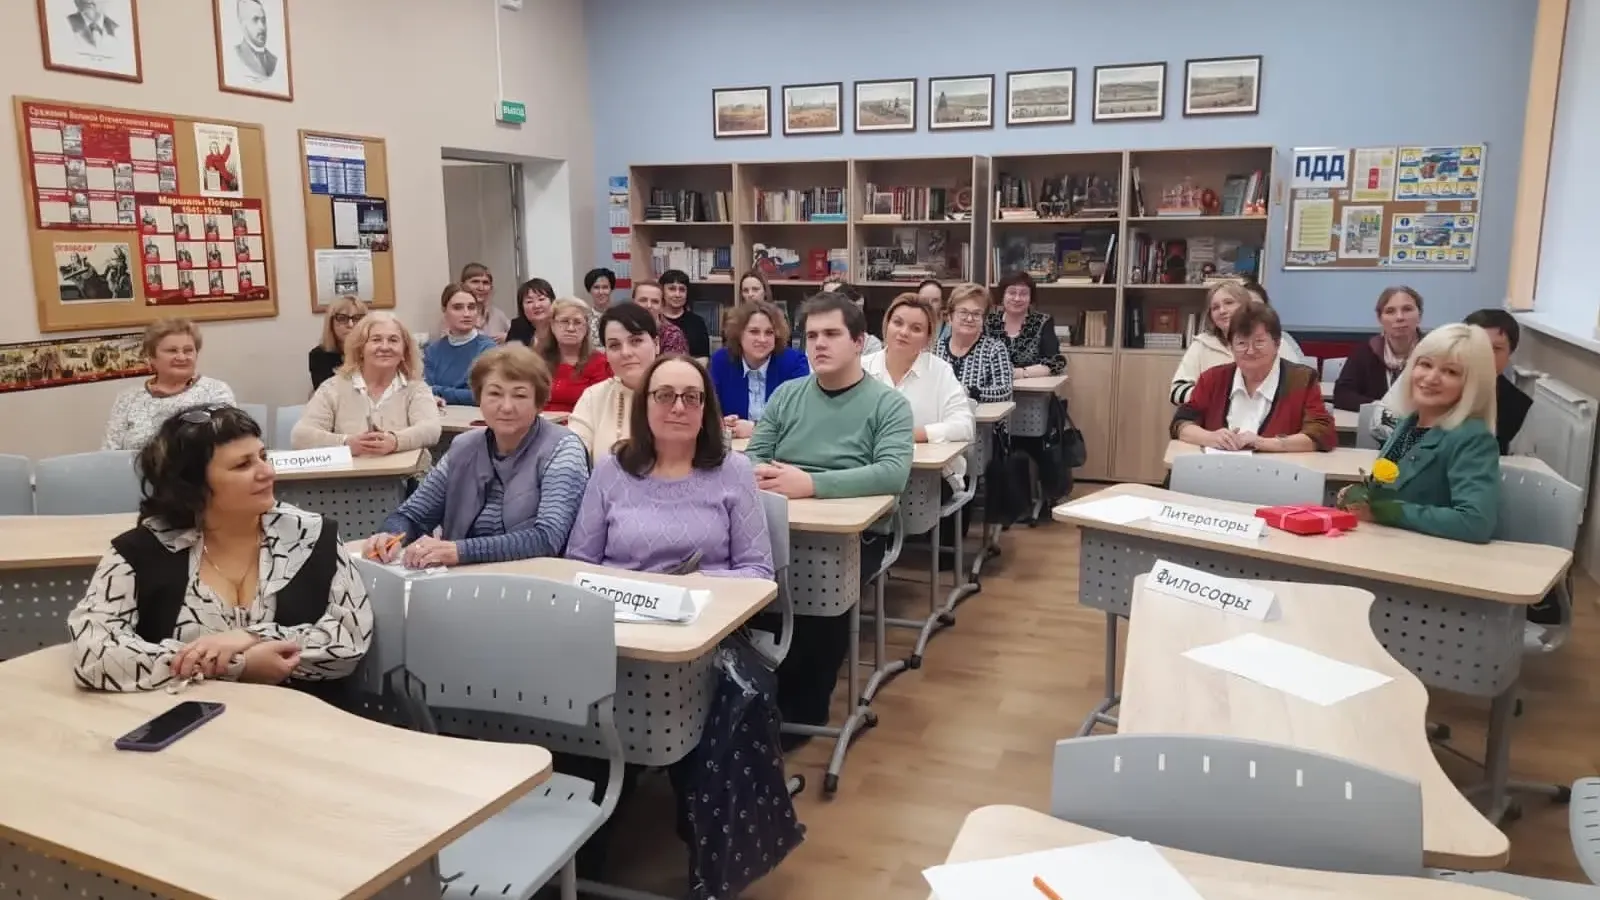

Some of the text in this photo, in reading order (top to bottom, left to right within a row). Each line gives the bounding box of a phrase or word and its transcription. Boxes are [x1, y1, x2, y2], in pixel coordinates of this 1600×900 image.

[503, 105, 524, 116] ВЫХОД
[1295, 155, 1345, 182] ПДД
[158, 195, 243, 207] Маршалы Победы
[182, 206, 222, 214] 1941-1945
[1160, 505, 1249, 532] Литераторы
[1156, 568, 1252, 611] Философы
